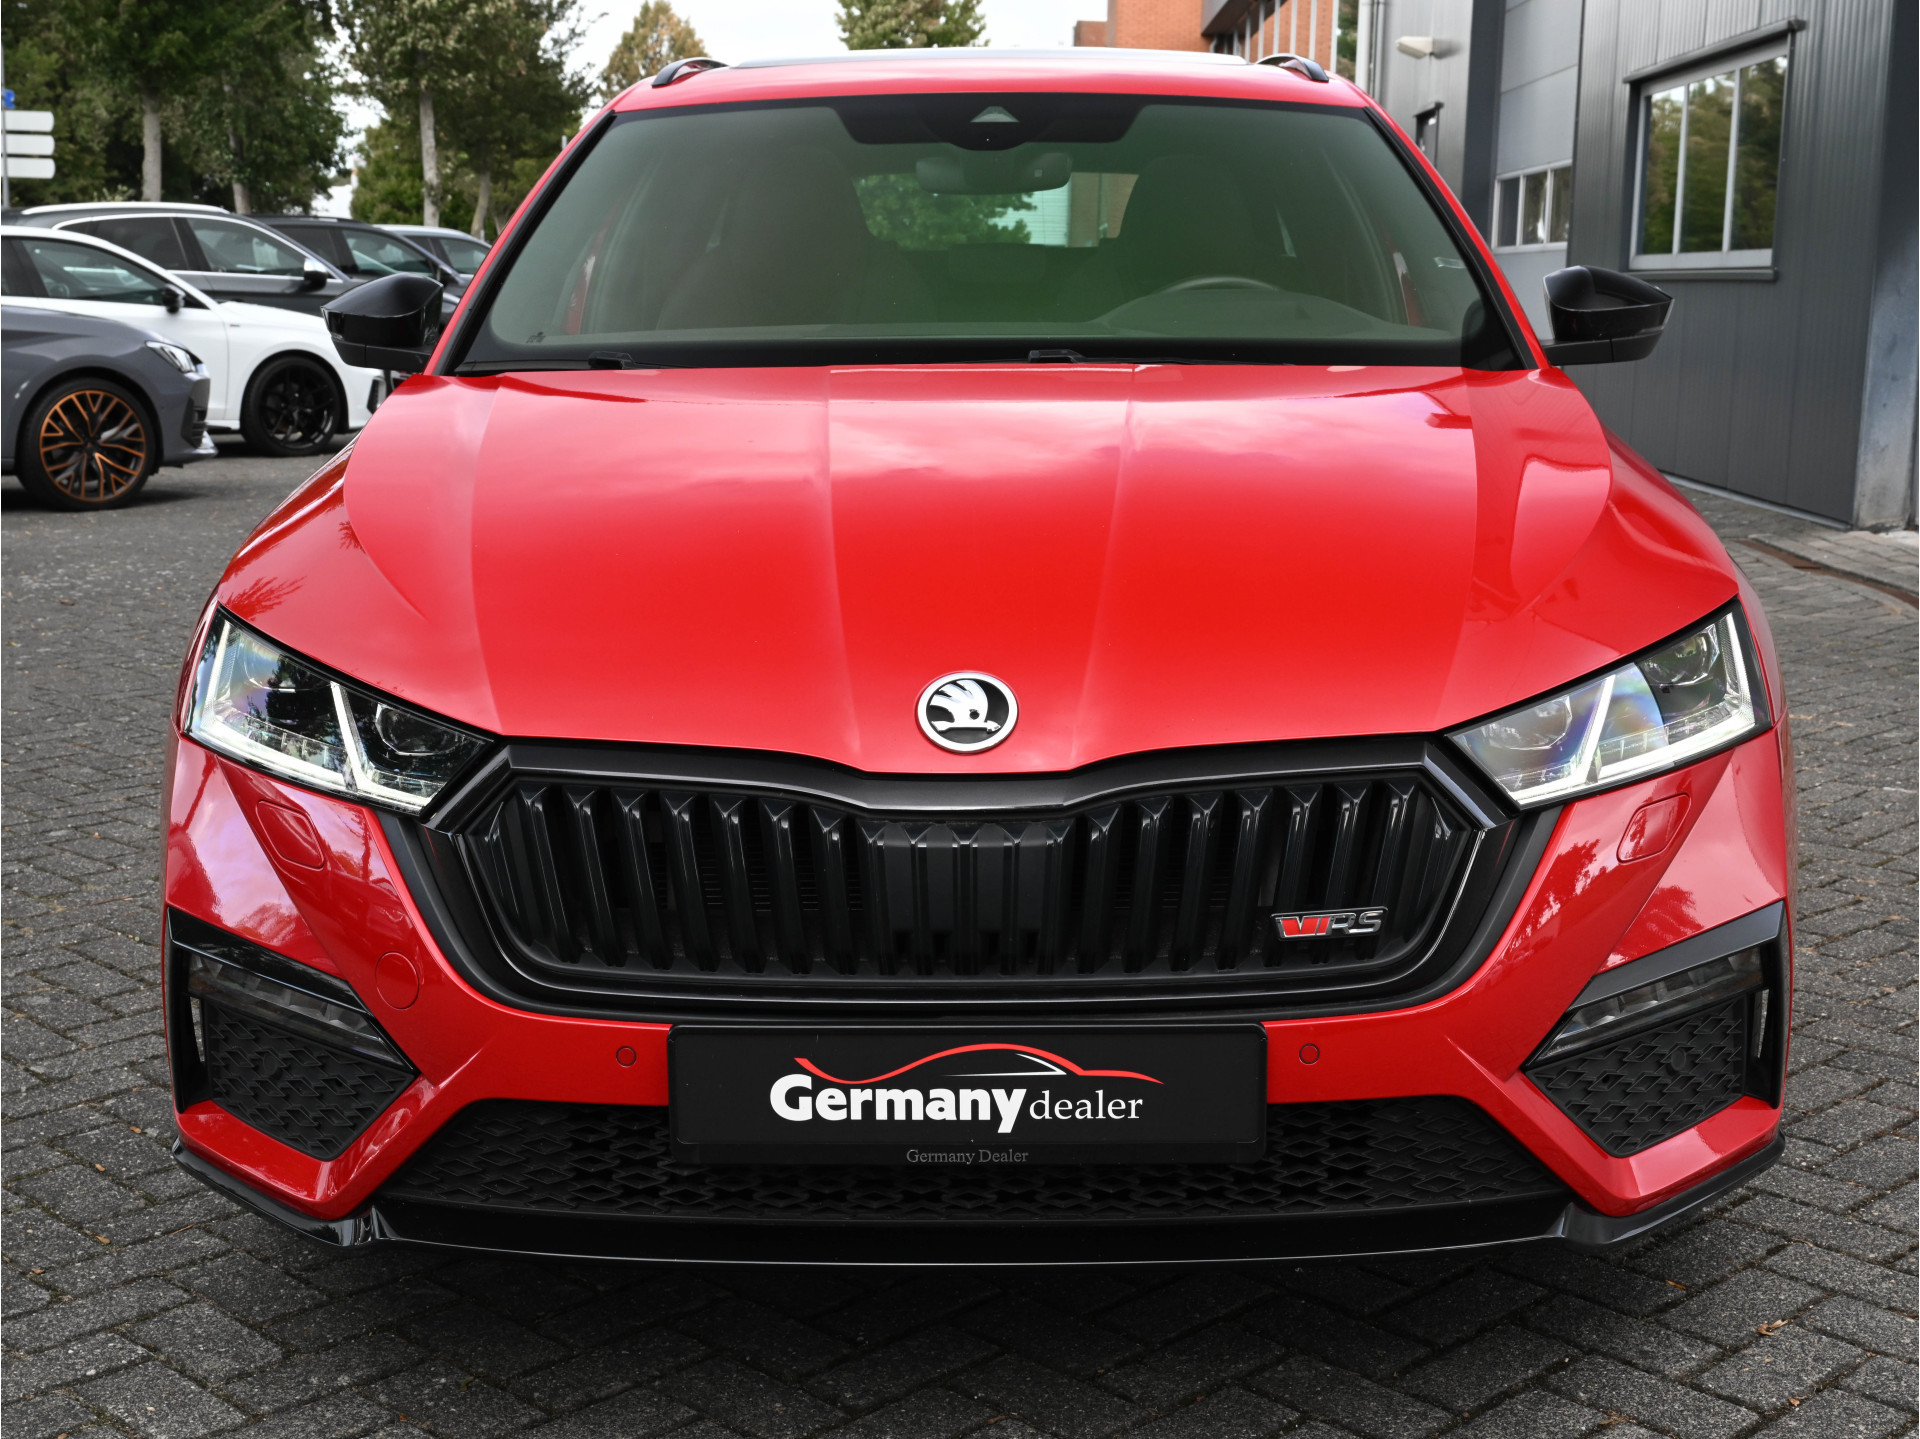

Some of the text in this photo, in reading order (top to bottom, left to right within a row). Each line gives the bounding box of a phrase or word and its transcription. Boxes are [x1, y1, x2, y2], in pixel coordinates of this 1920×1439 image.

[769, 1073, 1144, 1133] Germany dealer
[906, 1148, 1029, 1165] Germany Dealer
